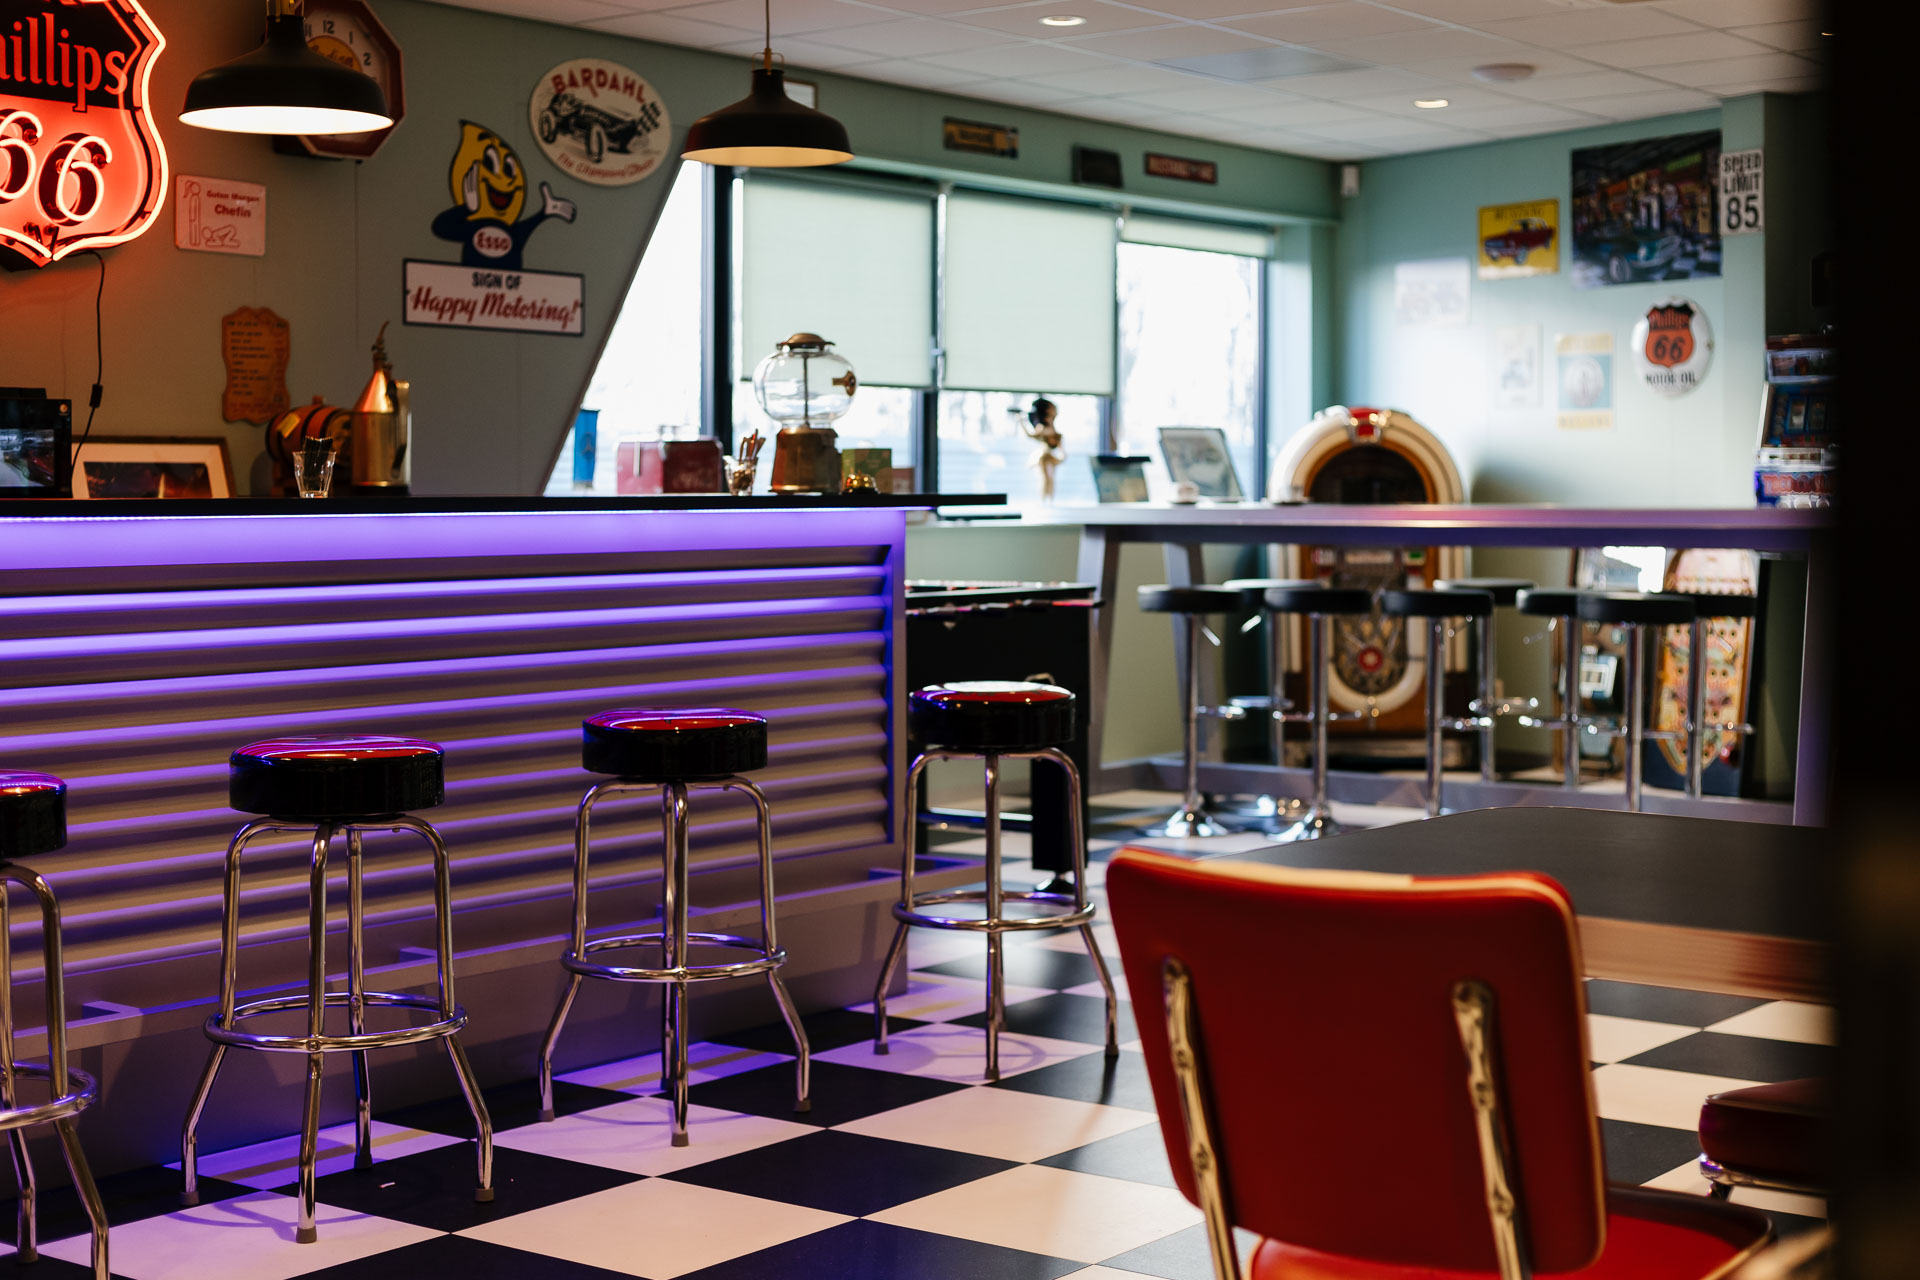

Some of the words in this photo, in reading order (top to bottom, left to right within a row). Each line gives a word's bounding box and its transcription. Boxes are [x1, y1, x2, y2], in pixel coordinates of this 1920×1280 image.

[323, 20, 335, 34] 12
[363, 52, 371, 66] 2
[551, 67, 646, 103] BARDAHL
[1724, 152, 1761, 173] SPEED
[1724, 172, 1760, 194] LIMIT
[214, 203, 251, 218] Chefin
[1727, 194, 1759, 230] 85
[476, 231, 509, 251] Esso
[472, 271, 503, 289] SIGN
[505, 274, 521, 290] OF
[412, 285, 478, 323] Happy
[479, 292, 580, 330] Motoring!
[1654, 335, 1685, 362] 66
[1646, 373, 1675, 385] MOTOR
[1681, 371, 1696, 383] OIL
